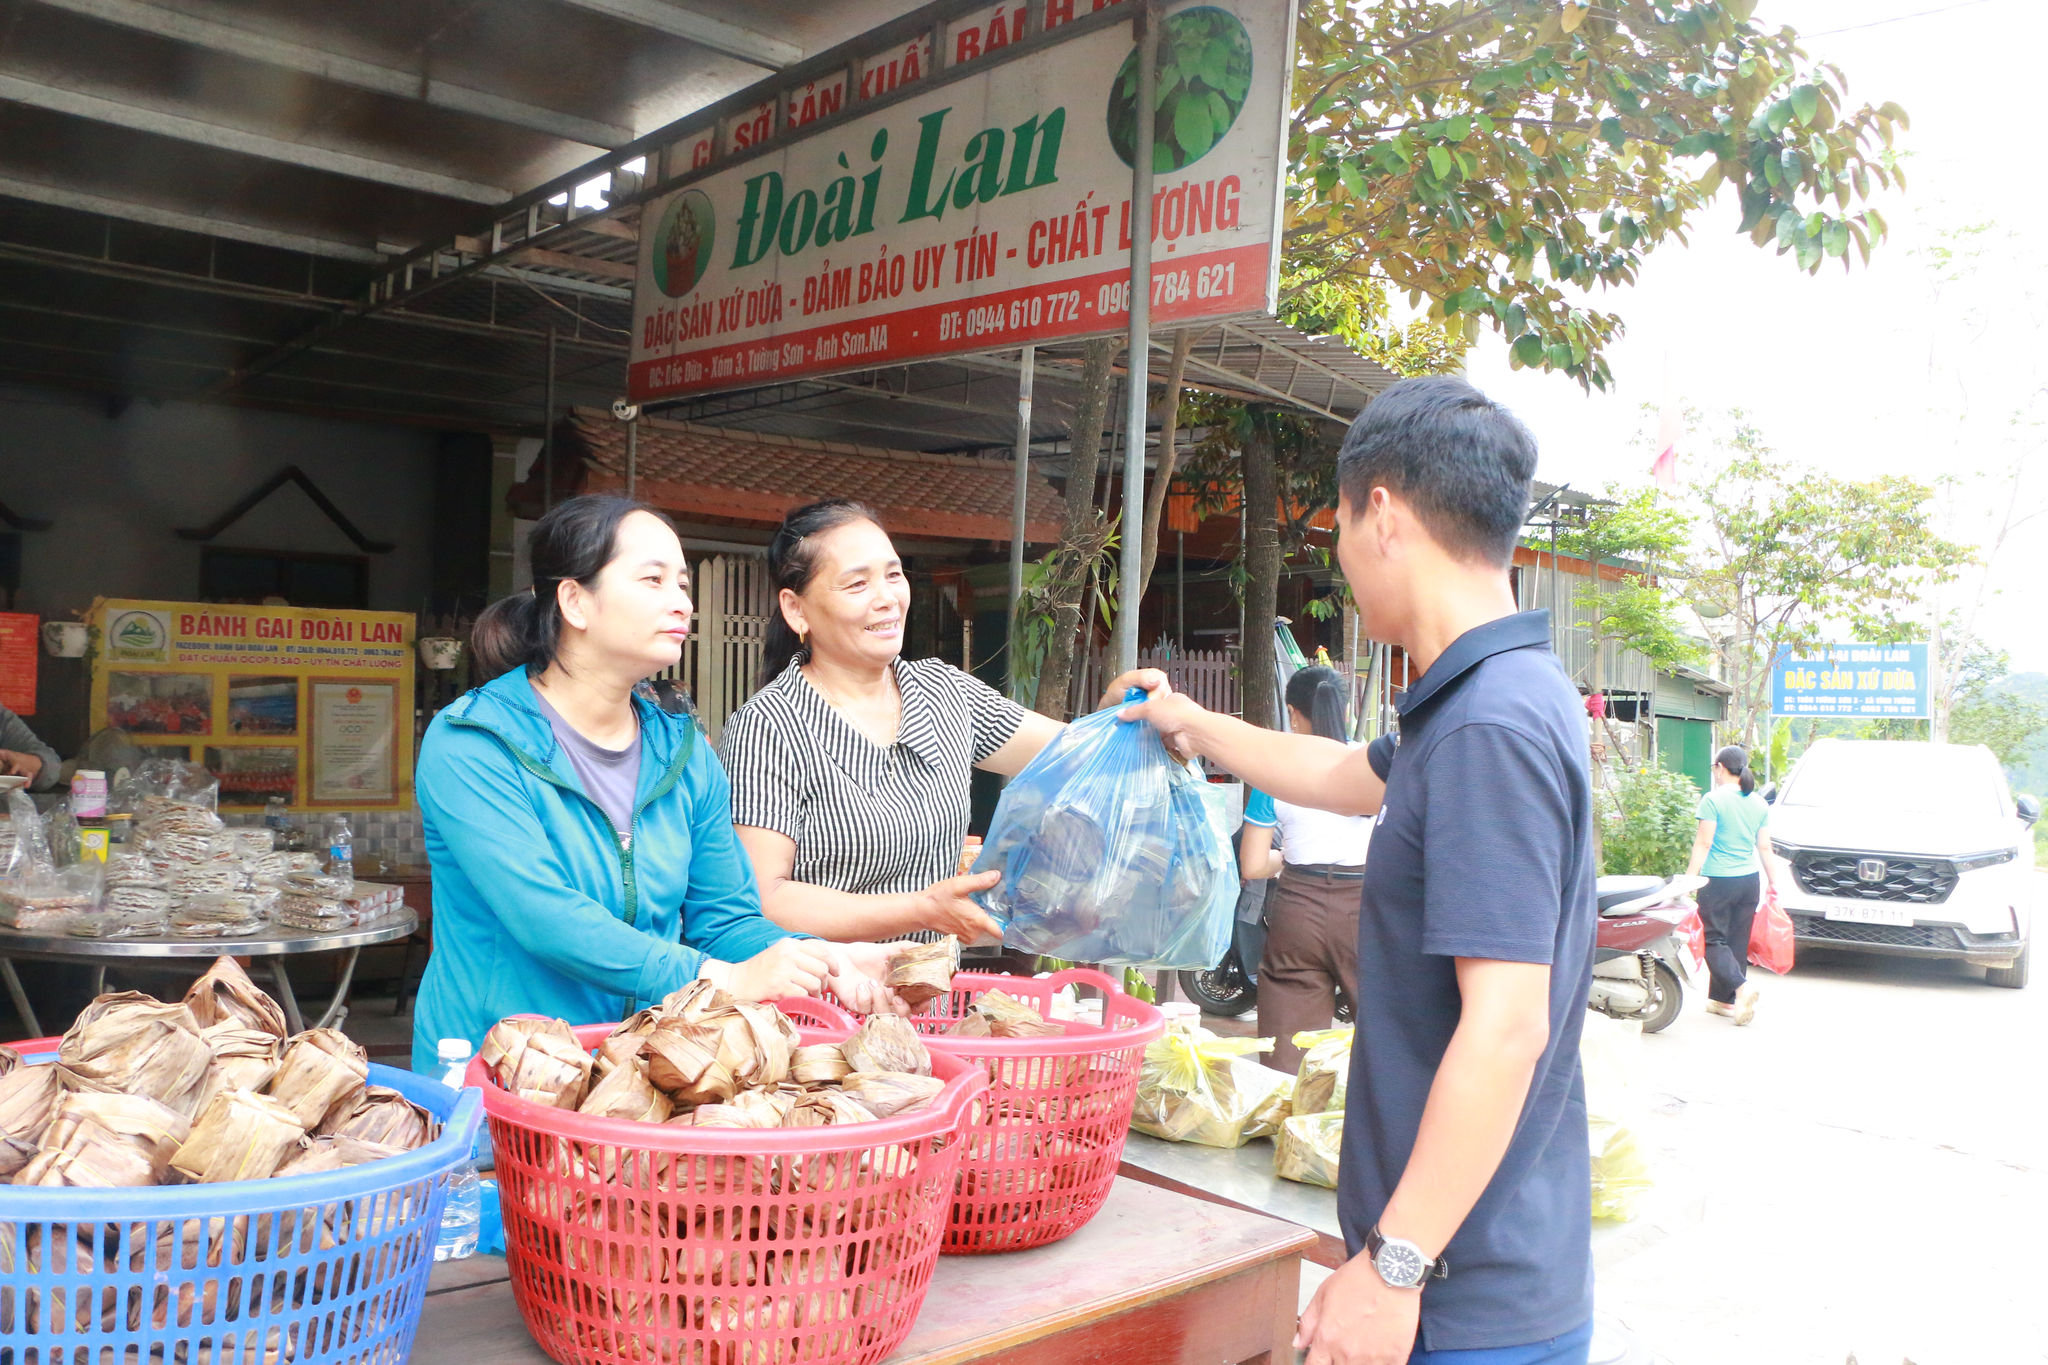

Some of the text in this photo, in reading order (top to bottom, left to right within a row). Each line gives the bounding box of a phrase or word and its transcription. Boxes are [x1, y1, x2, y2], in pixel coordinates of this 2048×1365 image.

[692, 138, 714, 169] C
[860, 33, 930, 100] XUẤ
[729, 106, 1066, 271] Đoài Lan
[643, 305, 676, 354] ĐẶC
[678, 292, 713, 342] SẢN
[717, 287, 745, 334] XỨ
[746, 280, 783, 329] DỪA
[802, 259, 852, 316] ĐẢM
[857, 244, 906, 304] BẢO
[912, 243, 947, 293] UY
[955, 226, 999, 284] TÍN
[1027, 191, 1110, 269] CHẤT
[711, 354, 733, 378] Xóm
[736, 352, 745, 377] 3,
[748, 346, 780, 373] Tường
[782, 343, 804, 368] Sơn
[815, 331, 838, 362] Anh
[841, 324, 889, 358] Sơn.NA
[939, 311, 963, 341] ĐT:
[966, 303, 1005, 338] 0944
[1009, 296, 1042, 328] 610
[1046, 289, 1080, 325] 772
[1098, 279, 1131, 317] 096
[1152, 270, 1190, 306] 784
[1197, 261, 1236, 300] 621
[180, 610, 402, 643] BÁNH GAI ĐOÀI LAN
[1784, 664, 1916, 694] ĐẶC SẢN XỨ DỪA
